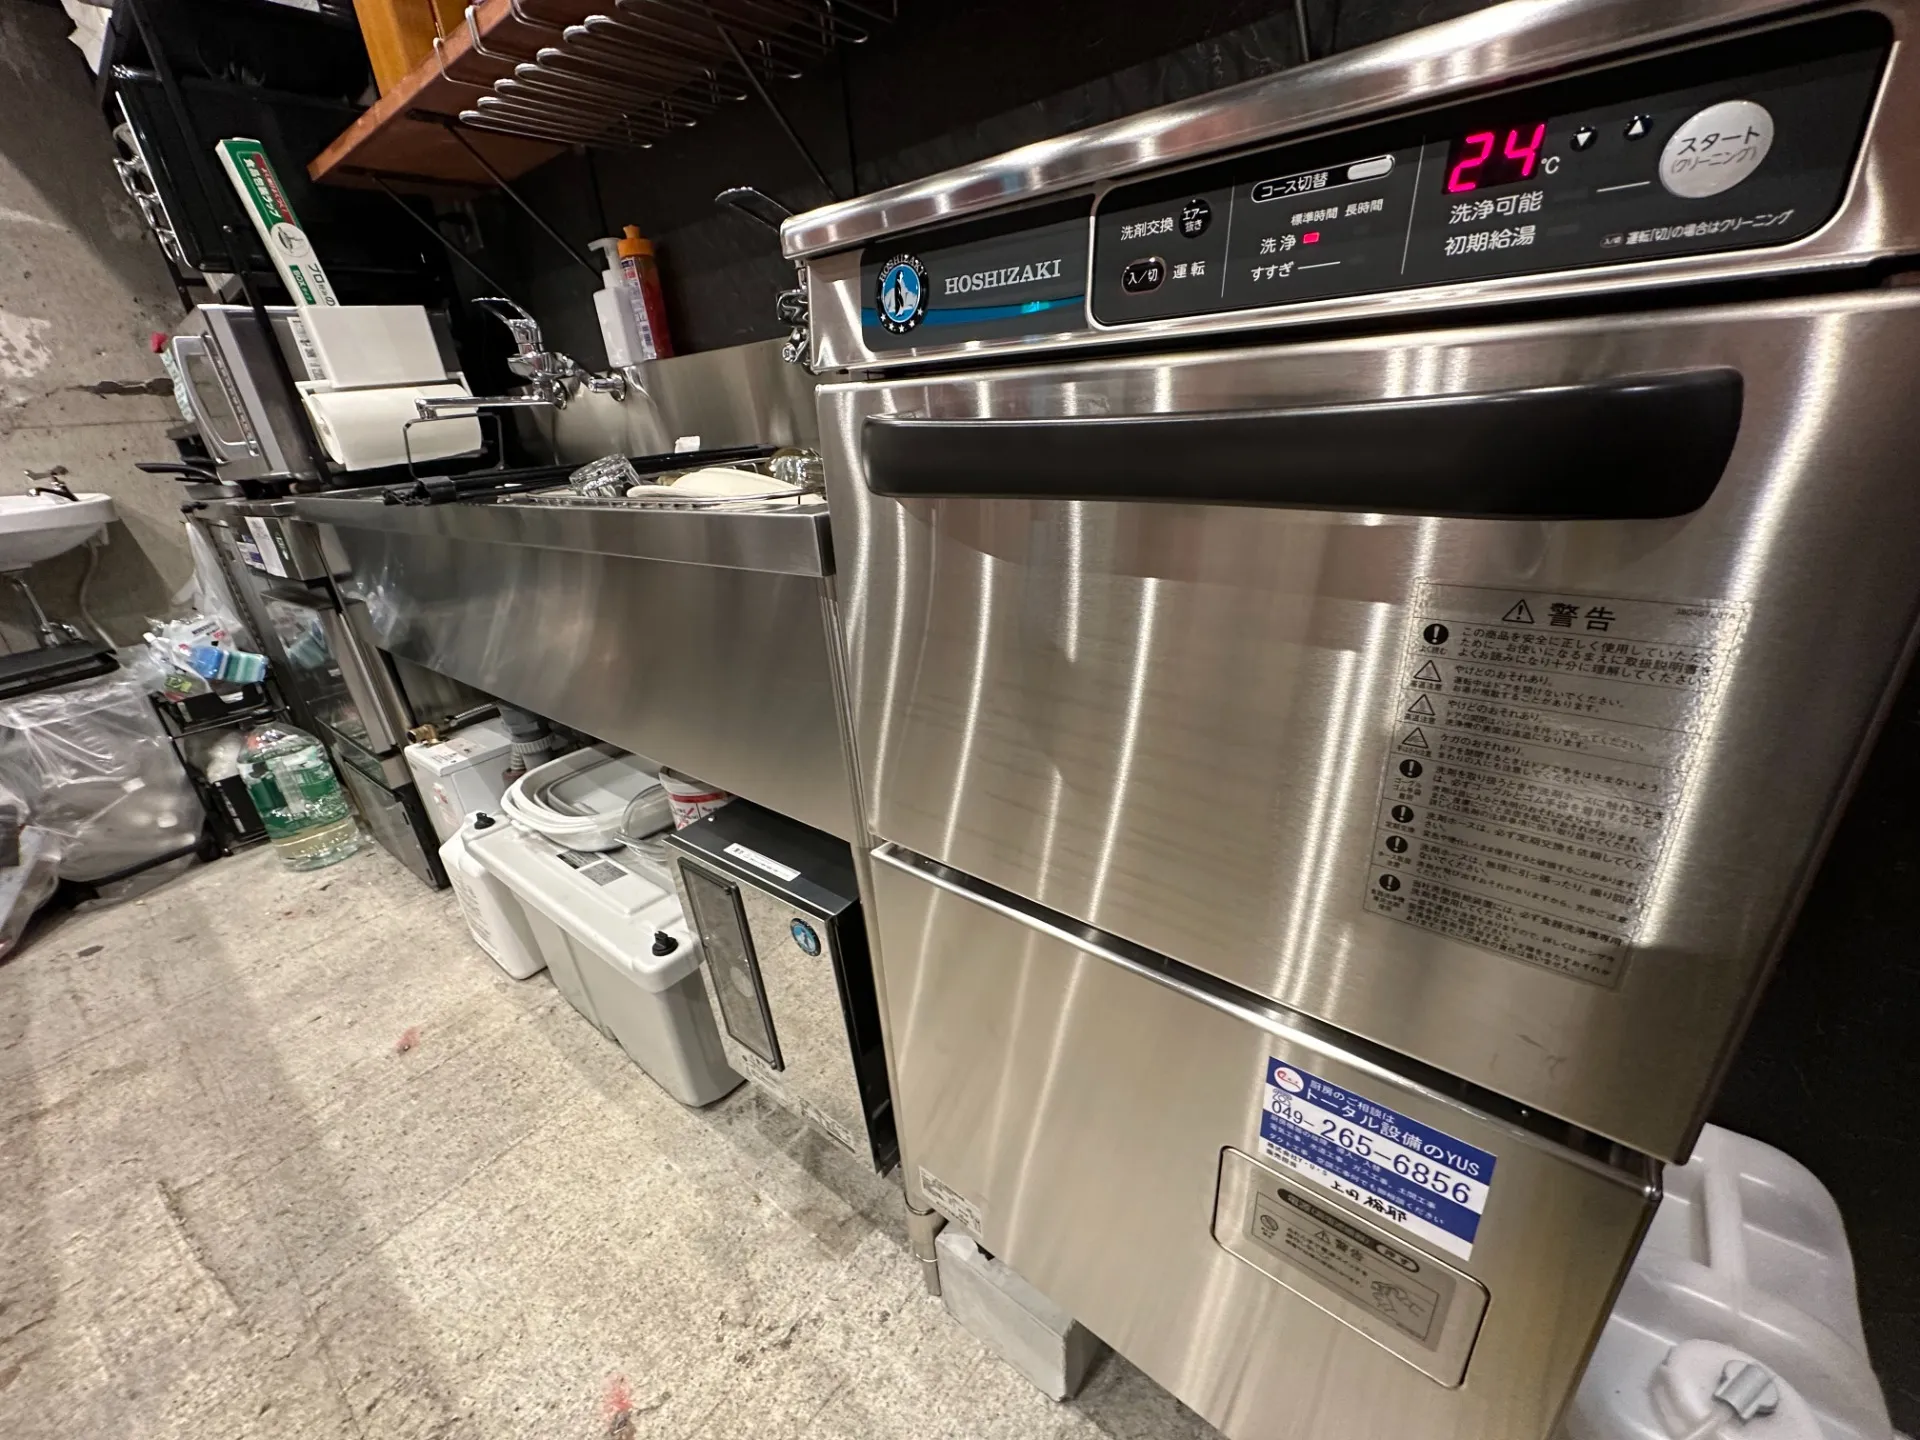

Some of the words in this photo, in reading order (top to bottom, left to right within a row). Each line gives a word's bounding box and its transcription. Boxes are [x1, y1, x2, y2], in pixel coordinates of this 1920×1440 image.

[1681, 130, 1760, 156] スタート
[1447, 123, 1546, 193] 24
[1260, 173, 1328, 198] コース切替
[1290, 206, 1338, 227] 標準時間
[1344, 198, 1384, 218] 長時間
[1448, 190, 1543, 225] 洗浄可能
[1120, 217, 1175, 242] 洗剤交換
[1185, 219, 1205, 232] 抜き
[1445, 224, 1537, 256] 初期給湯
[1259, 234, 1296, 255] 洗浄
[878, 253, 925, 283] HOSHIZAKI
[944, 259, 1062, 295] HOSHIZAKI
[1172, 260, 1206, 280] 運転
[1250, 261, 1295, 282] すすぎ
[1545, 602, 1619, 632] 警告
[1460, 627, 1717, 663] この商品を安全に正しく使用していただく
[1453, 663, 1554, 687] やけどのおそれあり。
[1446, 699, 1546, 723] やけどのおそれあり。
[1439, 732, 1525, 756] ケガのおそれあり。
[1309, 1079, 1395, 1125] 厨房のご相談は
[1305, 1087, 1481, 1178] トータル設備のYUS
[1320, 1116, 1472, 1206] 265-6856
